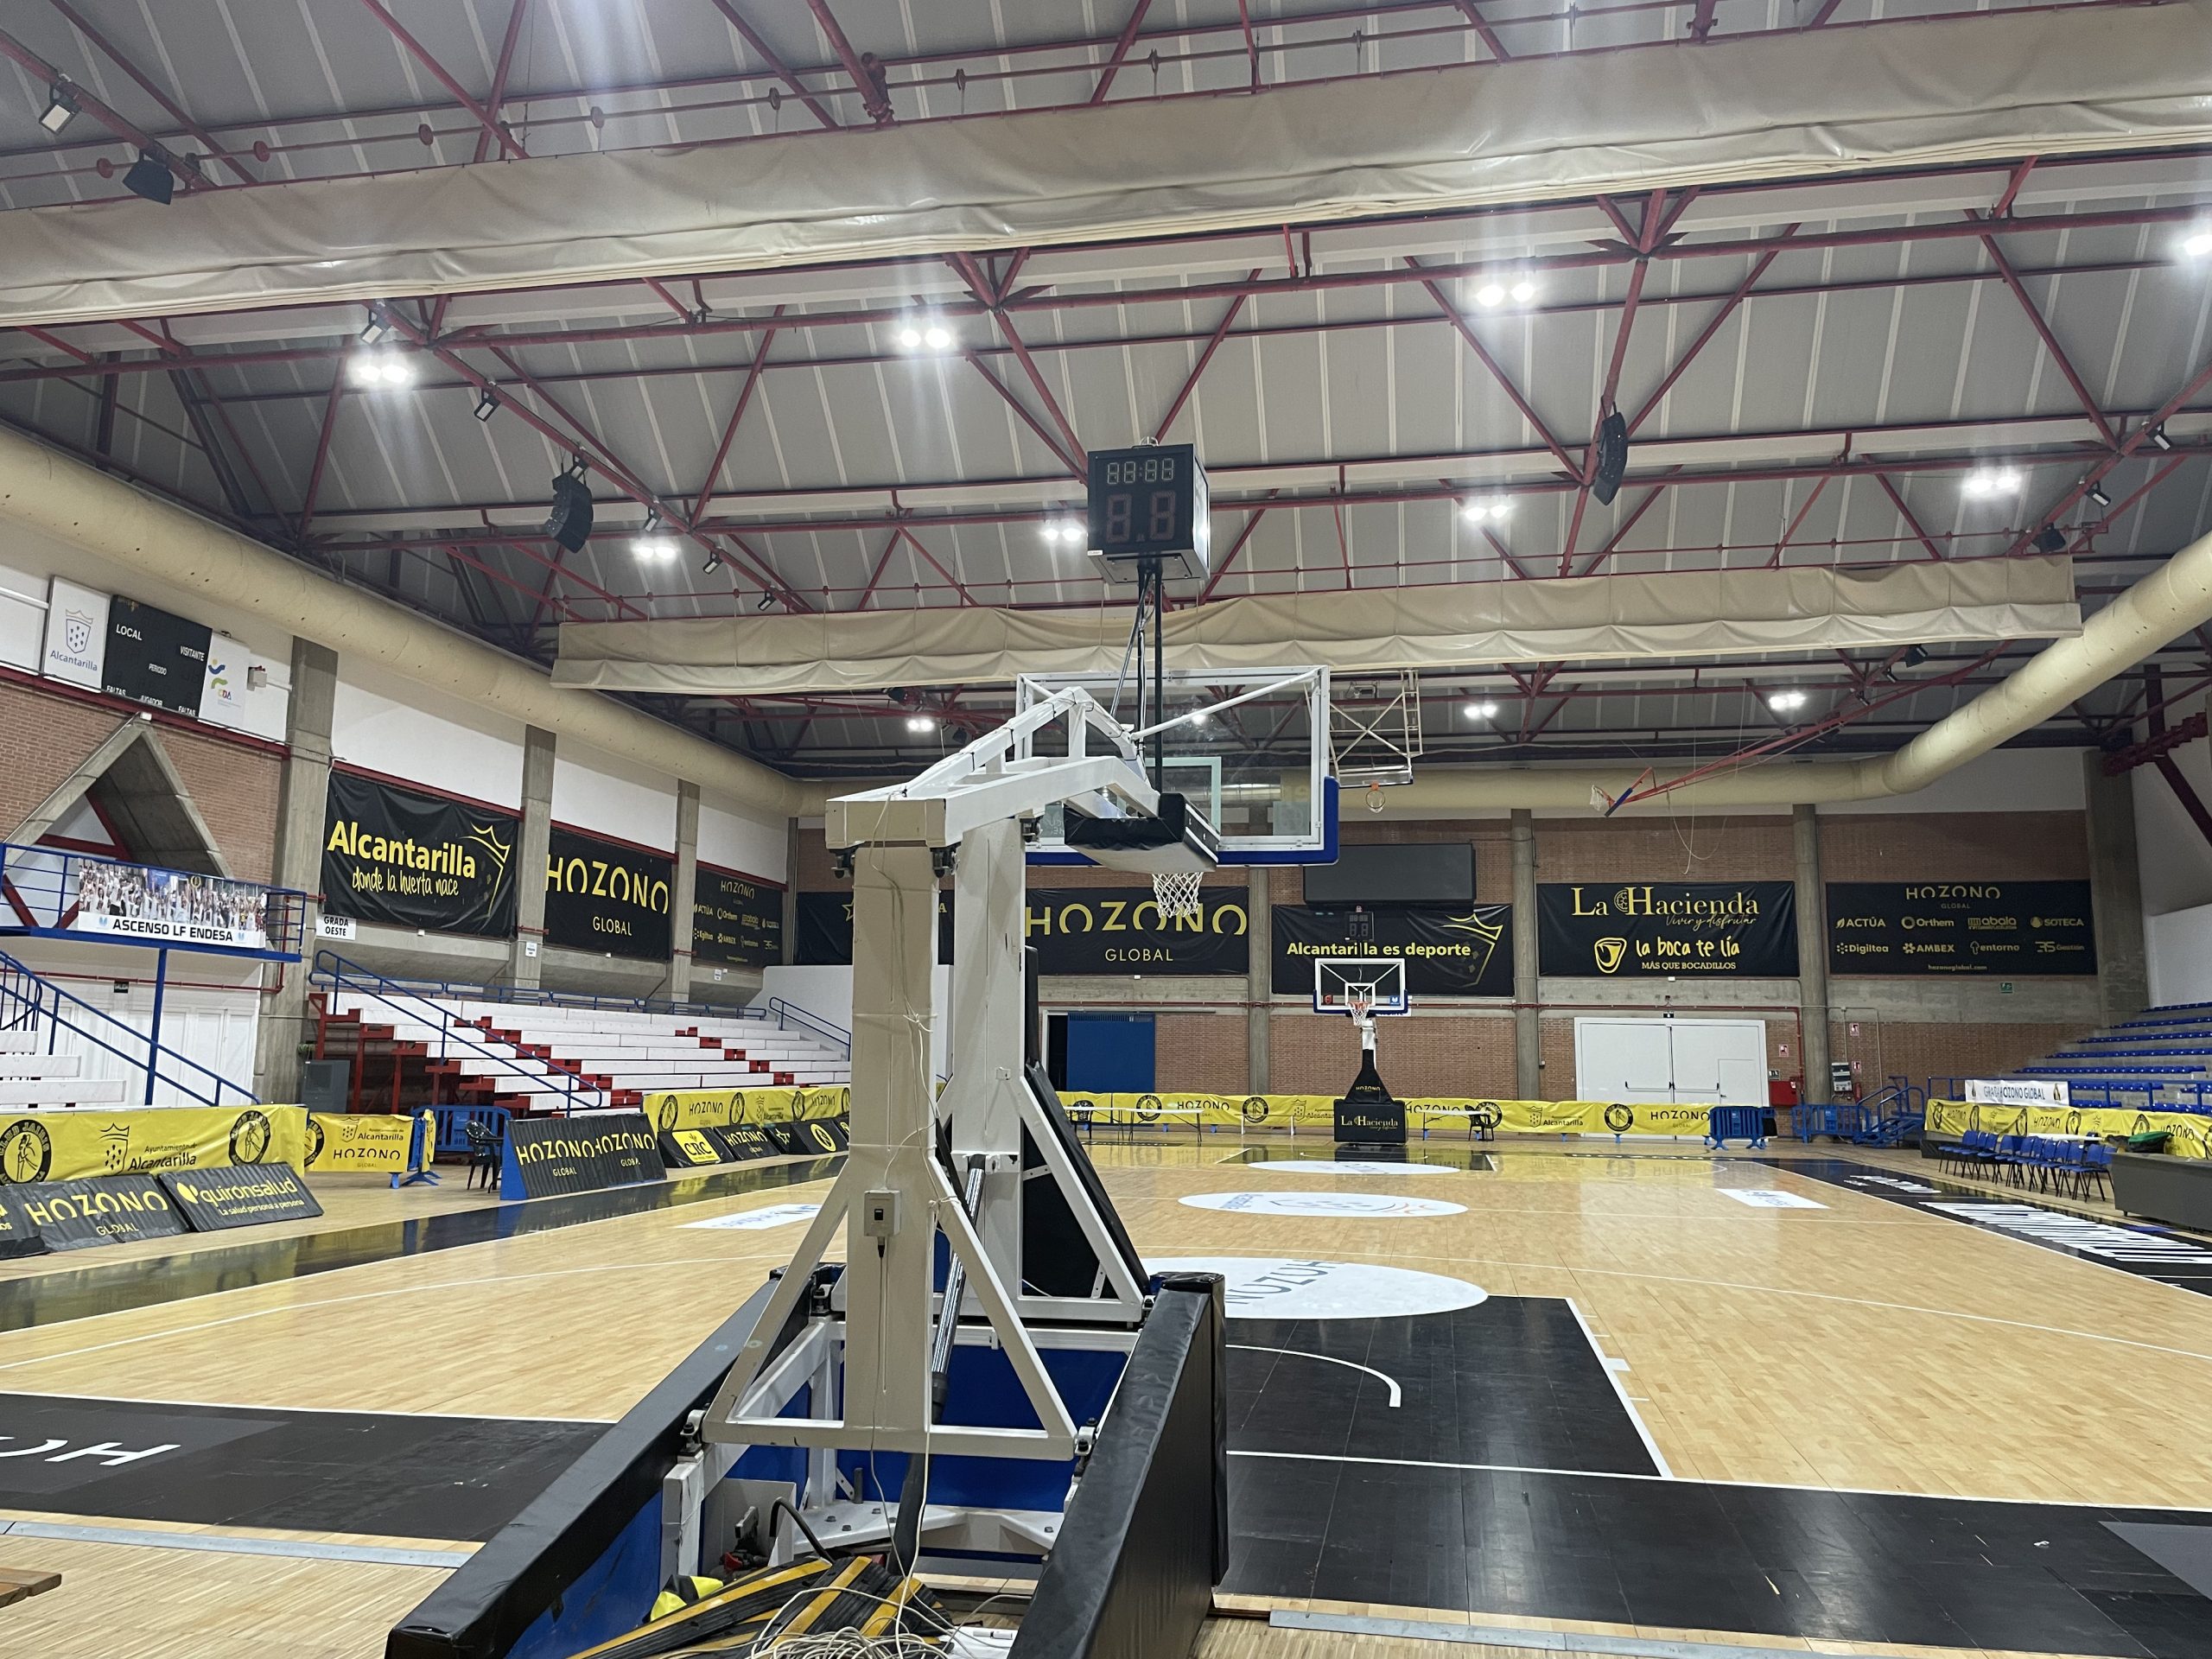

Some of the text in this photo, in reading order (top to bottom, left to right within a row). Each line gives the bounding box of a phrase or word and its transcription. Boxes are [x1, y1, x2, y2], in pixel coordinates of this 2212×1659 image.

[116, 624, 143, 641] LOCAL
[50, 650, 99, 671] Alcantarilla
[180, 645, 205, 662] VISITANTE
[148, 663, 168, 676] PERIODO
[106, 685, 126, 696] FALTAS
[178, 706, 196, 716] FALTAS
[327, 820, 475, 879] Alcantarilla
[352, 866, 459, 896] donde la huerta nace
[545, 854, 669, 914] HOZONO
[721, 880, 755, 899] HOZONO
[1905, 885, 2001, 900] HOZONO
[1571, 887, 1760, 916] La Hacienda
[323, 916, 349, 928] GRADA
[593, 916, 632, 937] GLOBAL
[1025, 900, 1248, 938] HOZONO
[1846, 916, 1886, 927] ACTÚA
[1916, 918, 1955, 927] Orthem
[2044, 918, 2084, 926] SOTECA
[112, 918, 233, 942] ASCENSO LF ENDESA
[325, 925, 347, 937] OESTE
[1287, 943, 1471, 959] Alcantarila es deporte
[1637, 936, 1740, 957] la boca te lía
[1105, 949, 1173, 962] GLOBAL
[1642, 960, 1661, 969] MÁS
[1662, 962, 1680, 970] QUE
[689, 1101, 723, 1116] HOZONO
[1177, 1100, 1230, 1112] HOZONO
[1341, 1116, 1353, 1126] La
[1651, 1110, 1710, 1121] HOZONO
[358, 1133, 404, 1141] Alcantarilla
[723, 1131, 768, 1147] HOZONO
[333, 1147, 401, 1160] HOZONO
[516, 1140, 595, 1166] HOZONO
[684, 1141, 712, 1156] CRC
[128, 1153, 197, 1172] Alcantarilla
[552, 1167, 578, 1177] GLOBAL
[24, 1191, 168, 1225] HOZONO
[229, 1205, 247, 1215] salud
[247, 1204, 274, 1214] persona
[279, 1199, 305, 1211] persona
[96, 1223, 139, 1236] GLOBAL
